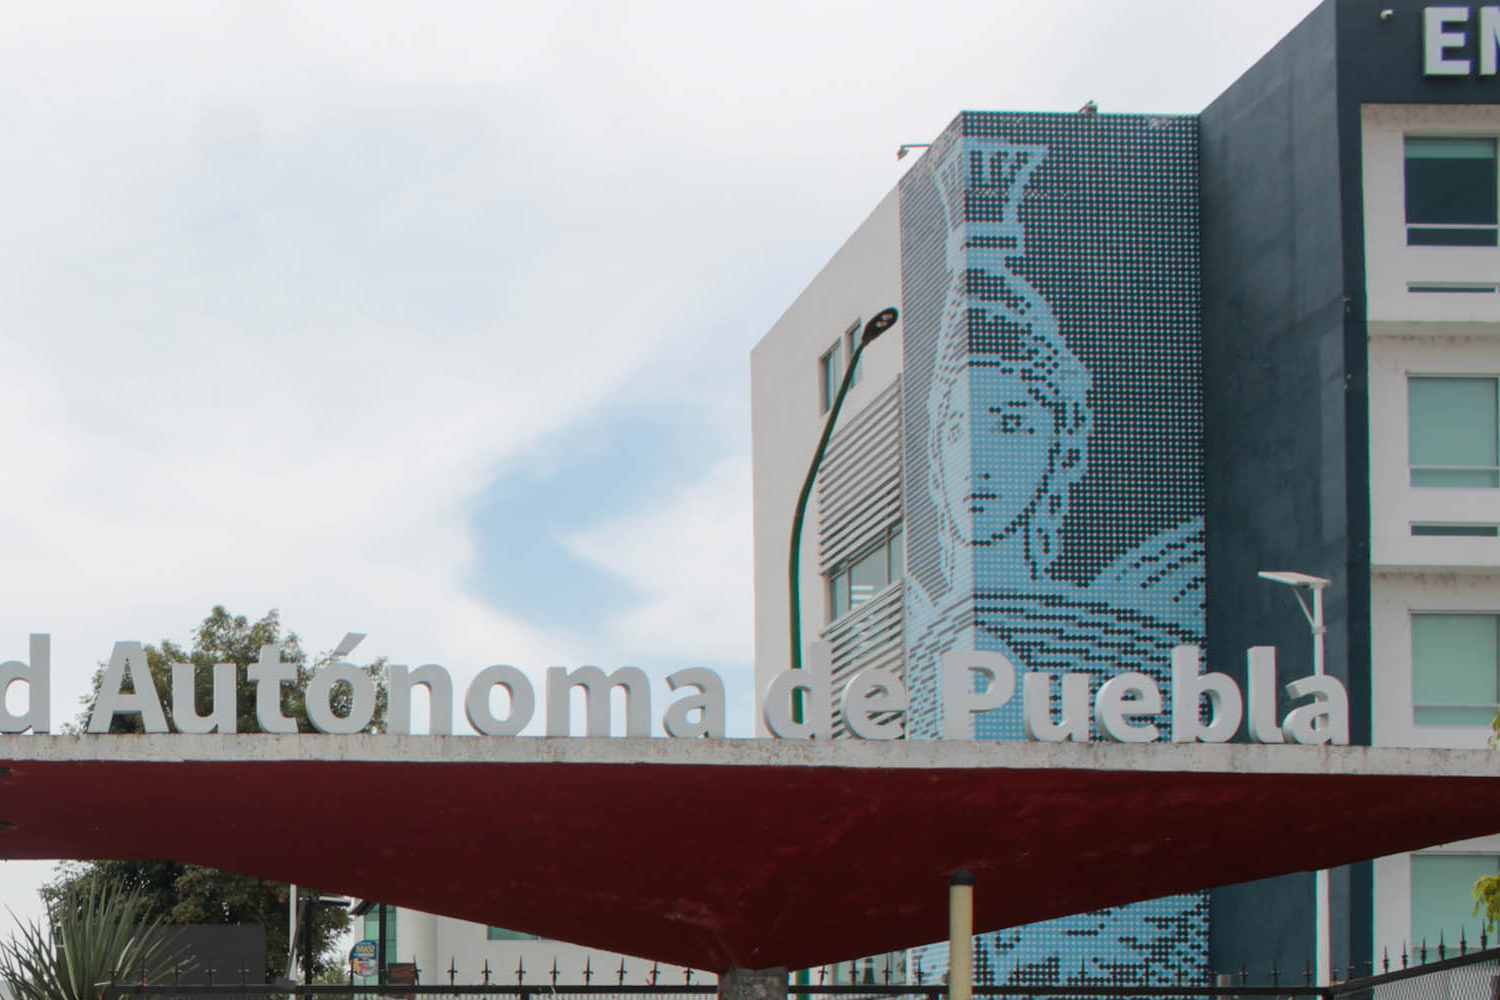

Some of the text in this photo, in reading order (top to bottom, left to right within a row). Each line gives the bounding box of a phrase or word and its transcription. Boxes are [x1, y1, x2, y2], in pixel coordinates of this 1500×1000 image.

[87, 632, 726, 738] Autónoma
[762, 641, 905, 740] de
[940, 646, 1350, 745] Puebla
